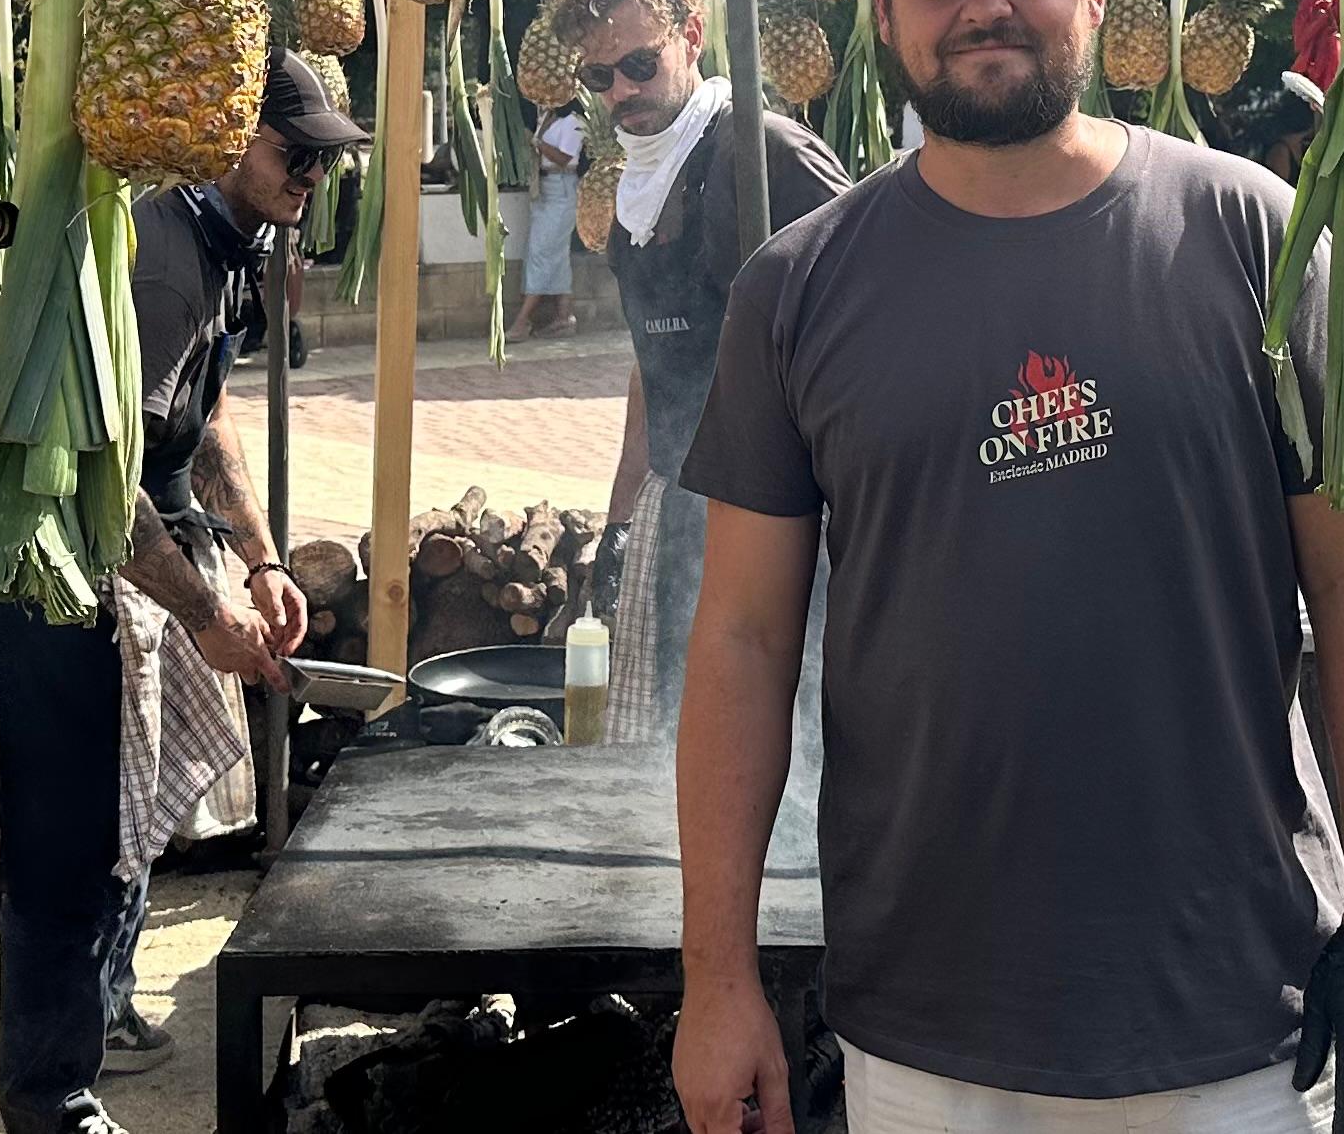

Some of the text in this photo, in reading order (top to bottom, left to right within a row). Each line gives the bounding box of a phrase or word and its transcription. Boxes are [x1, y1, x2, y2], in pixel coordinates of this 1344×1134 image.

[991, 379, 1097, 428] CHEFS
[979, 408, 1114, 465] ON FIRE
[1045, 443, 1108, 472] MADRID
